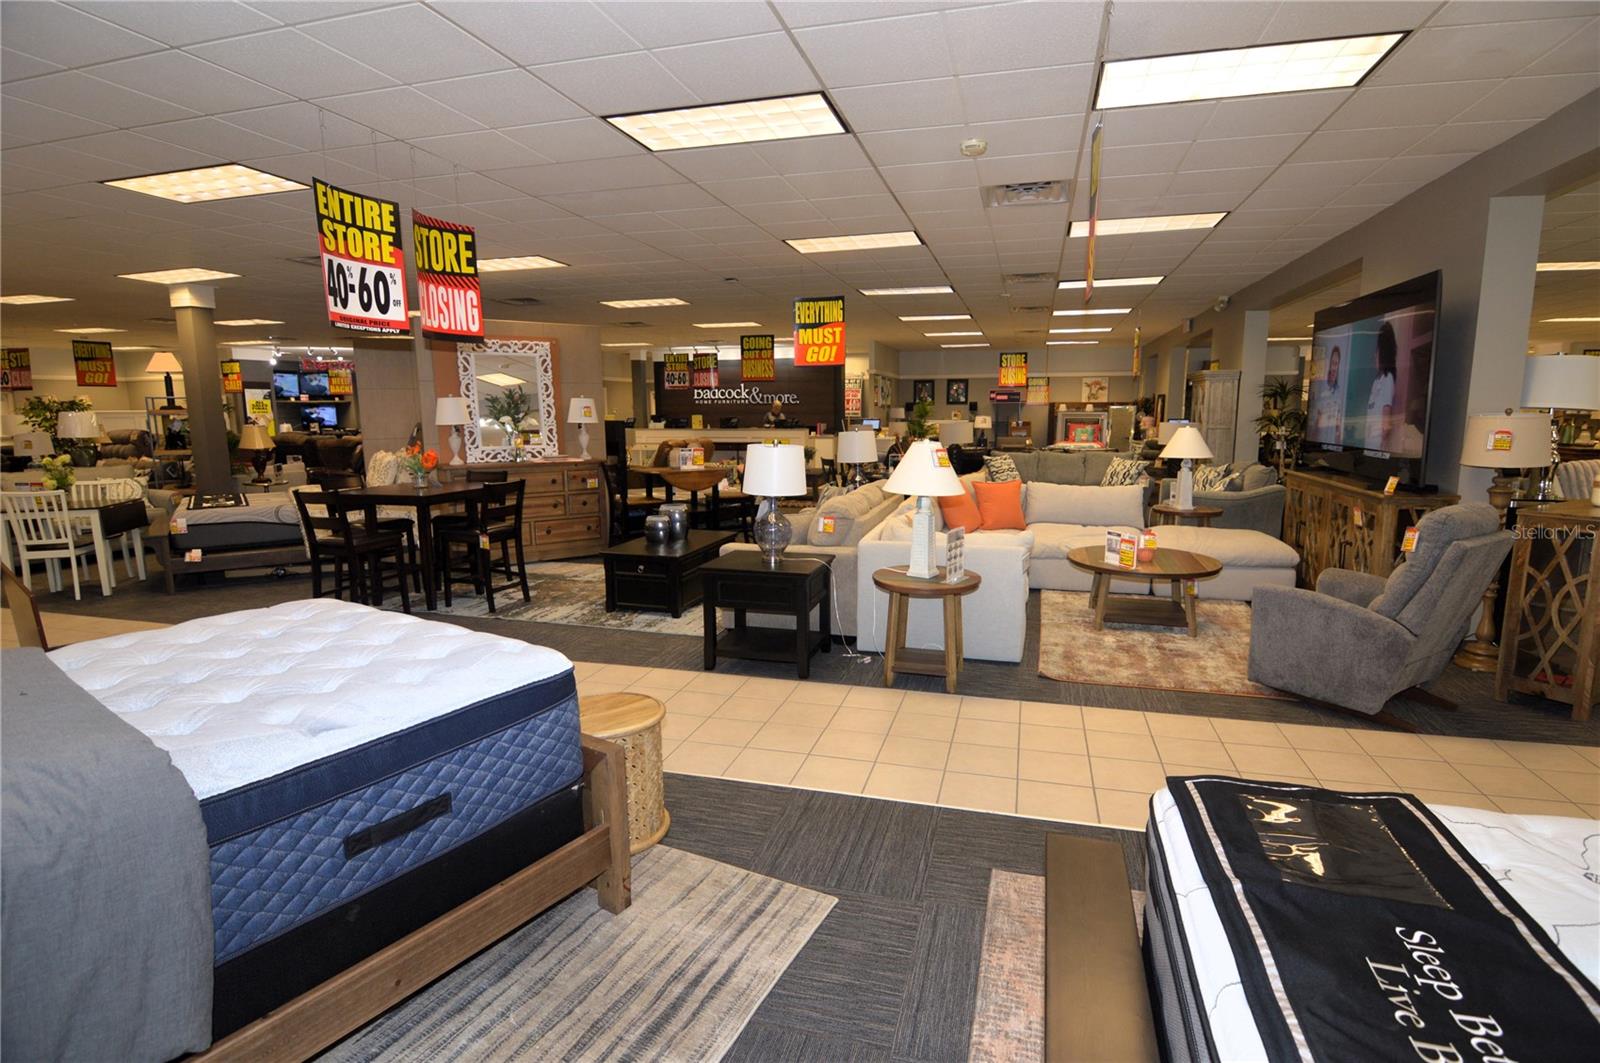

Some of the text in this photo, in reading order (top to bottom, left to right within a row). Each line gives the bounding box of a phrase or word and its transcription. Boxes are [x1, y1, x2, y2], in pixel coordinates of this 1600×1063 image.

[316, 182, 395, 233] ENTIRE
[322, 219, 395, 264] STORE
[413, 223, 475, 274] STORE
[418, 280, 480, 333] CLOSING
[795, 299, 843, 324] EVERYTHING
[339, 315, 368, 325] ORIGINAL
[350, 324, 381, 333] EXCEPTIONS
[369, 319, 391, 327] PRICE
[743, 337, 772, 349] GOING
[798, 327, 842, 345] MUST
[693, 355, 717, 369] STORE
[743, 350, 772, 359] OUT OF
[805, 345, 837, 362] GO!
[1001, 354, 1026, 367] STORE
[78, 360, 112, 372] MUST
[666, 363, 688, 371] STORE
[742, 359, 774, 378] BUSINESS
[85, 372, 110, 384] GO!
[1001, 367, 1027, 385] CLOSING
[1394, 926, 1464, 1001] Sleep
[1365, 956, 1426, 1029] Live
